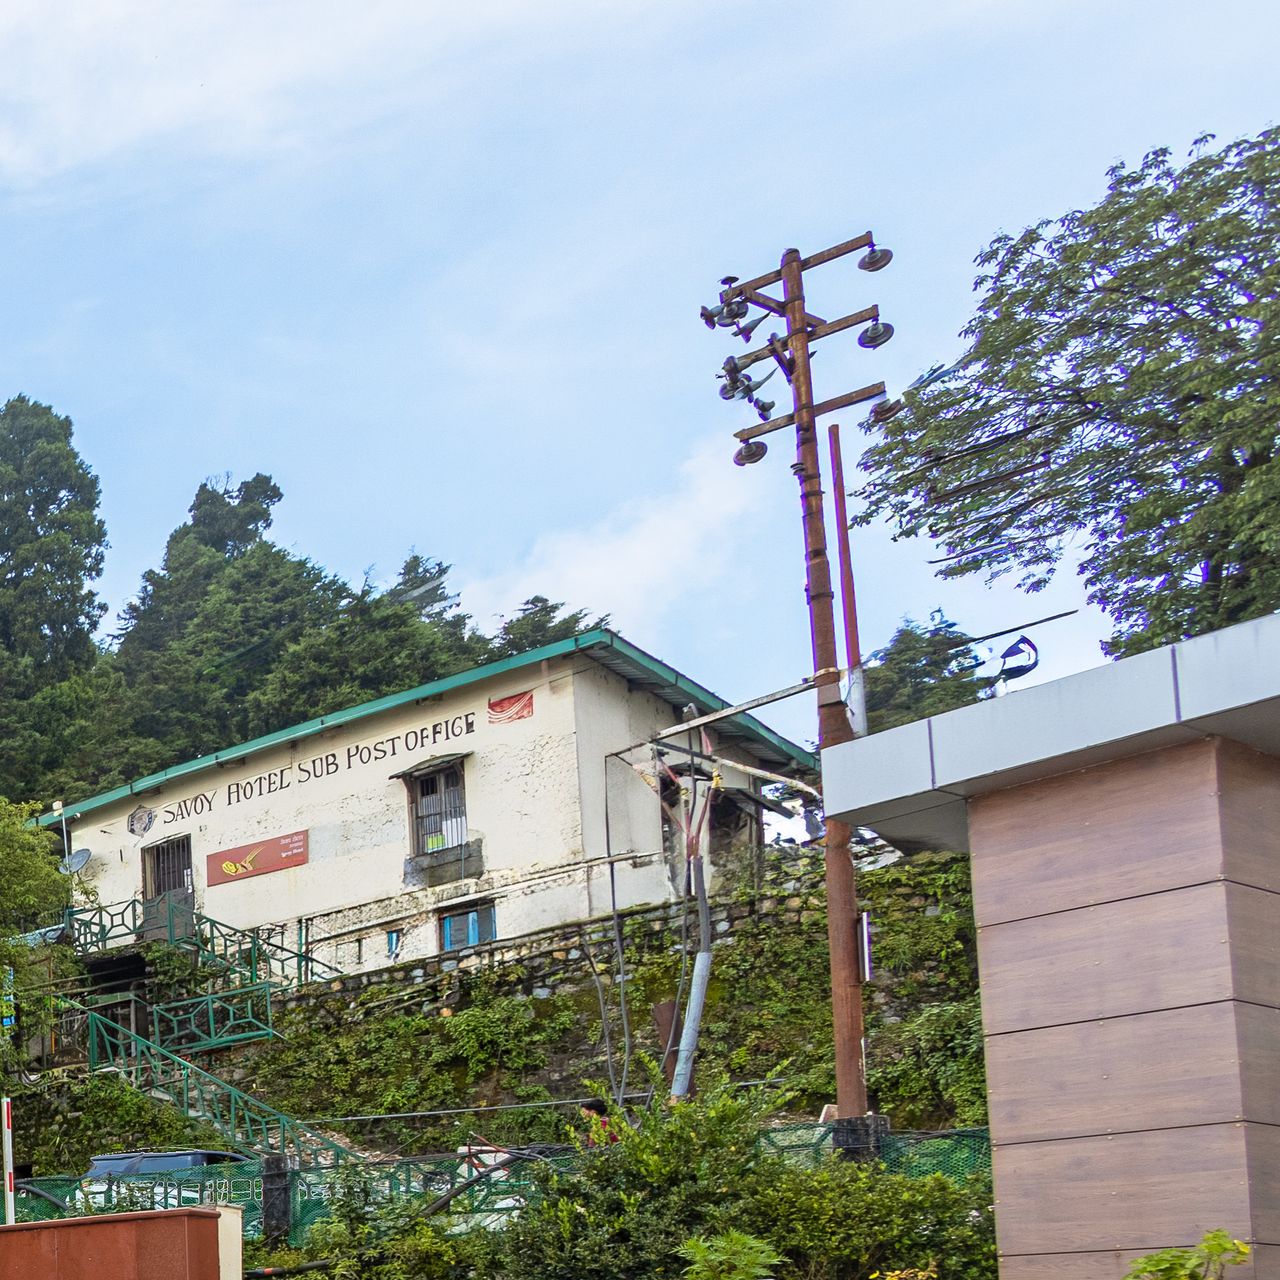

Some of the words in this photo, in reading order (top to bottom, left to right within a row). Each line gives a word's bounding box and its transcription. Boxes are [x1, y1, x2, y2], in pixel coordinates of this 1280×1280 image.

[163, 790, 217, 825] SAVOY
[227, 766, 292, 806] HOTEL
[297, 756, 340, 785] SUB
[346, 734, 402, 770] POST
[403, 712, 476, 753] OFFICE
